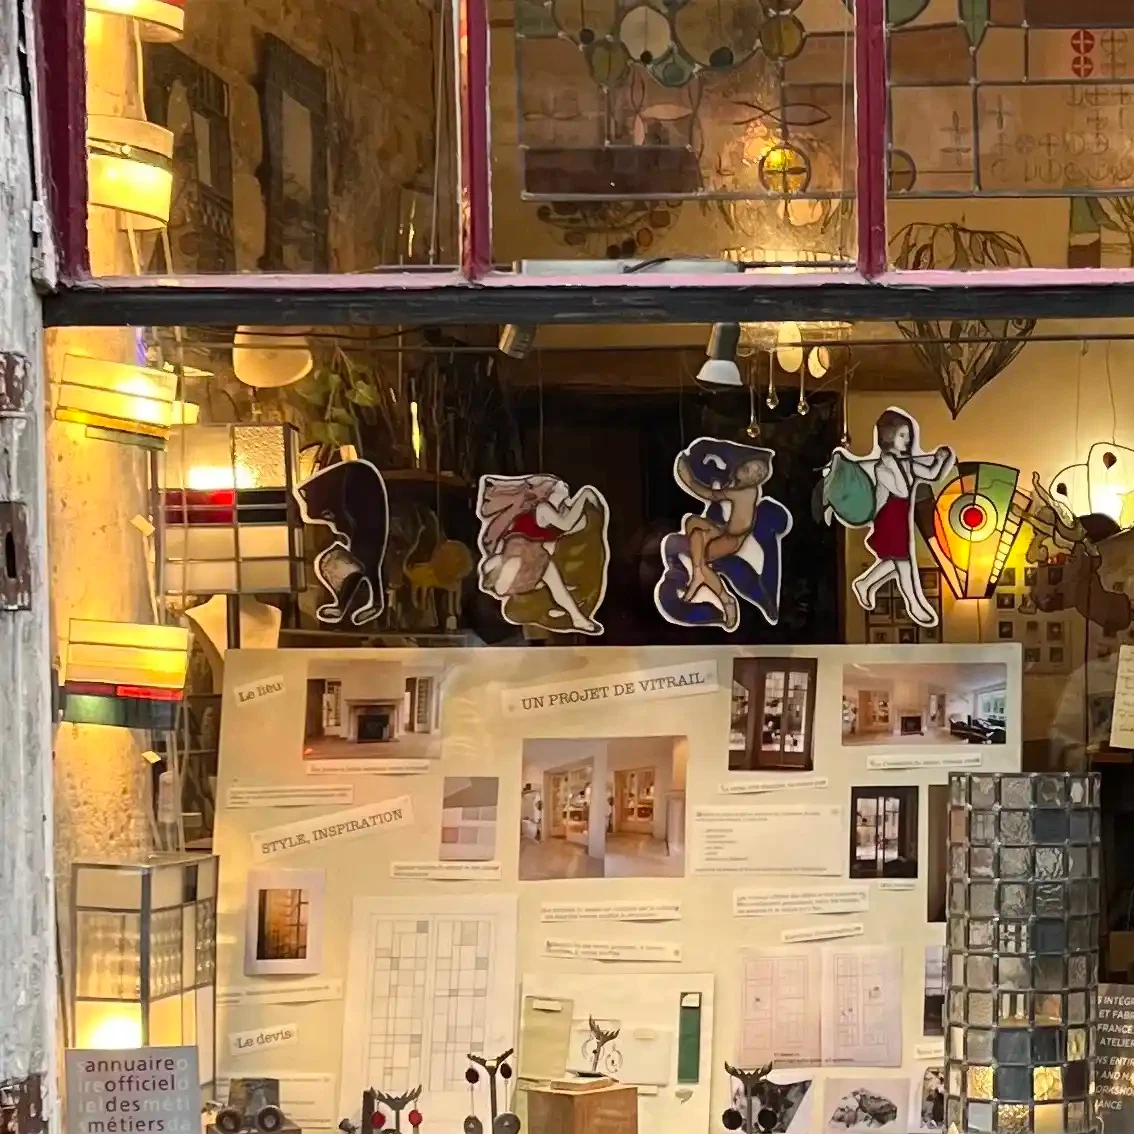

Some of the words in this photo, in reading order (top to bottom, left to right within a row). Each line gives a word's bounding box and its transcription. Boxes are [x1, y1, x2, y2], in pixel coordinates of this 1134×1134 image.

[522, 696, 544, 710] UN
[549, 686, 610, 706] PROJET
[614, 682, 635, 696] DE
[639, 672, 705, 692] VITRAIL
[261, 833, 311, 855] STYLE,
[312, 808, 403, 842] INSPIRATION
[236, 1036, 254, 1049] Le
[256, 1028, 293, 1045] devis
[84, 1056, 175, 1073] annuaire
[104, 1074, 175, 1093] officiel
[1101, 1071, 1121, 1081] AND
[105, 1096, 141, 1112] des
[87, 1116, 165, 1133] métiers
